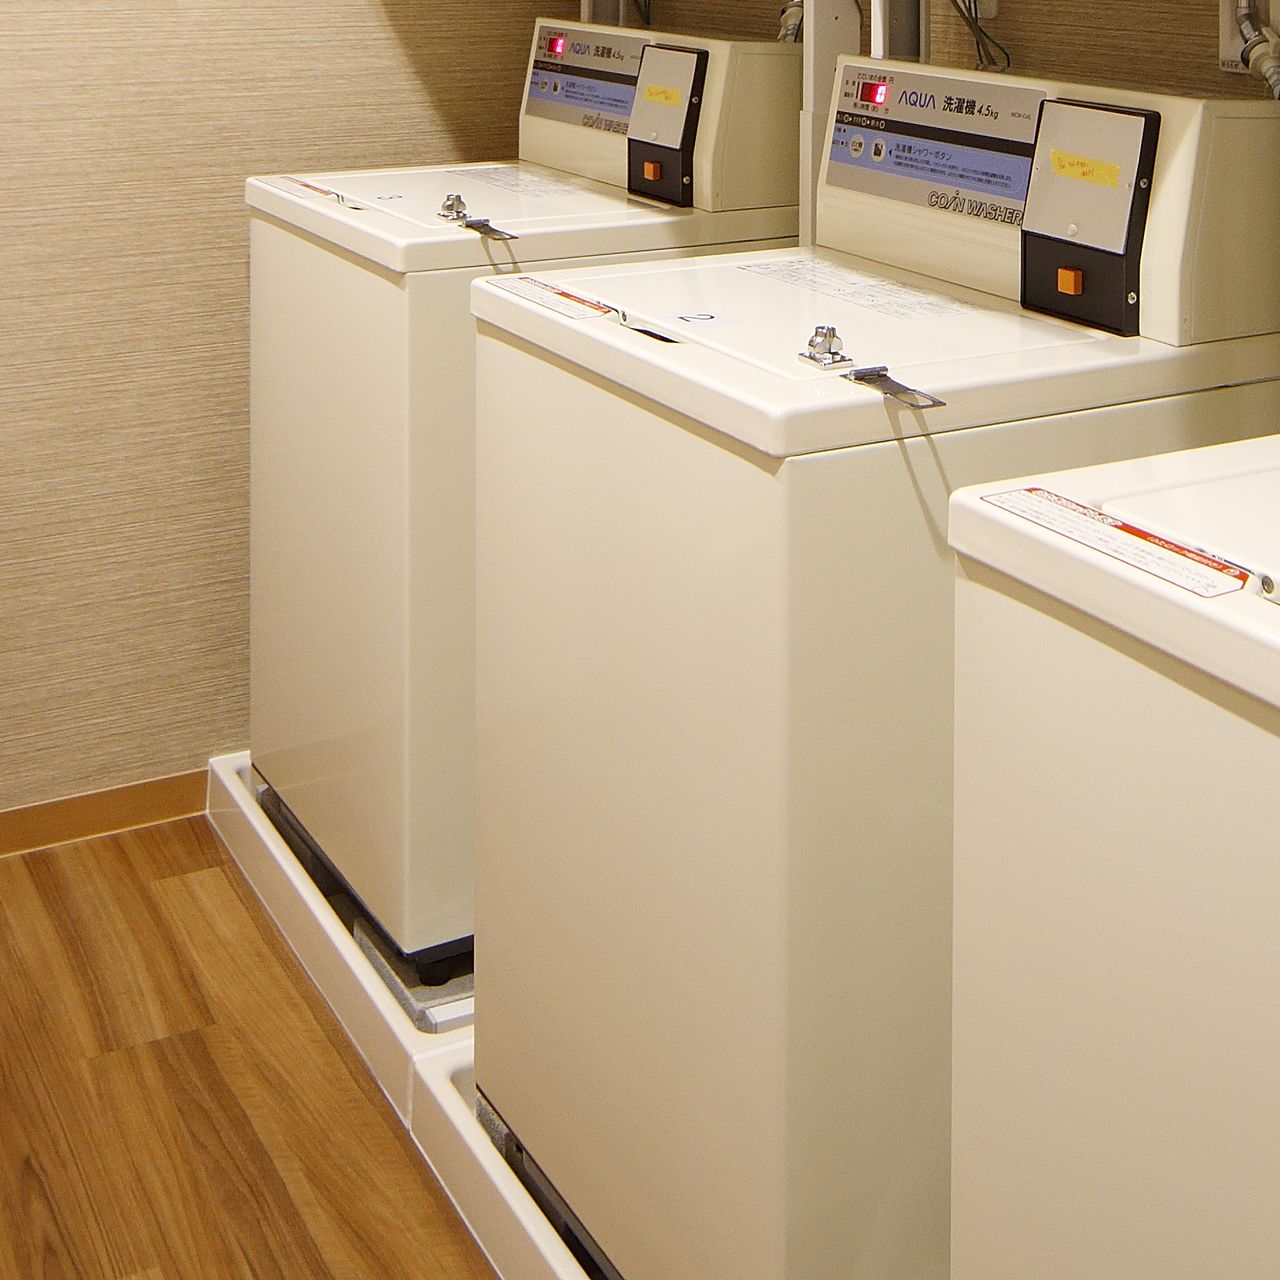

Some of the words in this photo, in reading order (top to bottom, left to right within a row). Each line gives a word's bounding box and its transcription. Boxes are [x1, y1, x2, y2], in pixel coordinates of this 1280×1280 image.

[898, 90, 936, 110] AQUA
[942, 95, 976, 117] 洗濯機
[977, 103, 999, 120] 4.5kg
[928, 190, 967, 214] COIN
[967, 200, 1024, 226] WASHER
